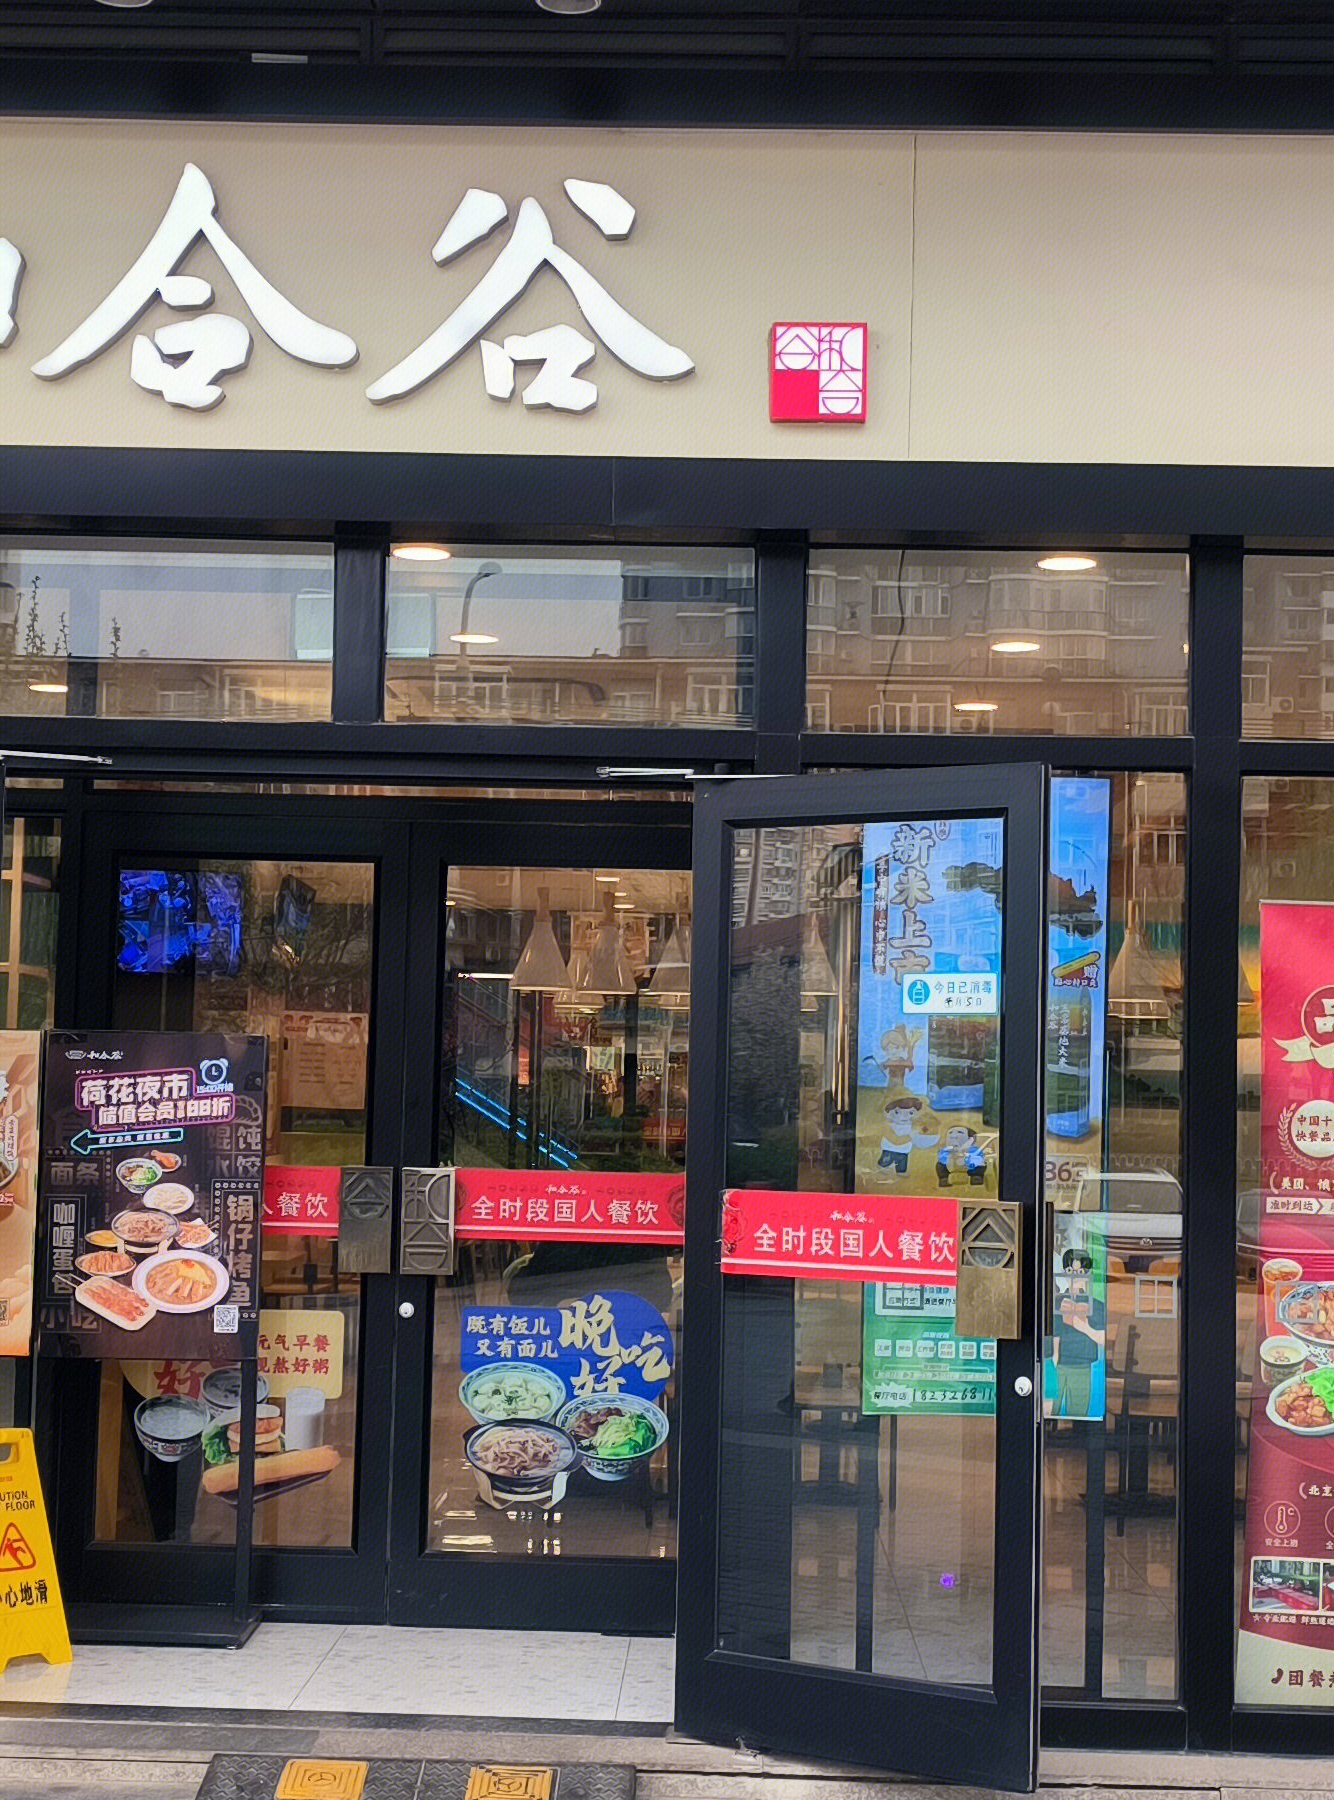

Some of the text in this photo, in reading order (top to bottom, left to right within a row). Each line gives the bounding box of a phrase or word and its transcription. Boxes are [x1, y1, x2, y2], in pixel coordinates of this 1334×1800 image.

[80, 1073, 190, 1106] 荷花夜市
[50, 1161, 100, 1185] 面条
[261, 1191, 328, 1219] 餐饮
[471, 1195, 660, 1225] 全时段国人餐饮
[753, 1222, 956, 1263] 全时段国人餐饮
[467, 1313, 551, 1336] 既有饭儿
[258, 1333, 331, 1352] 元气早餐
[476, 1337, 559, 1358] 又有面儿
[5, 1499, 36, 1512] FLOOR
